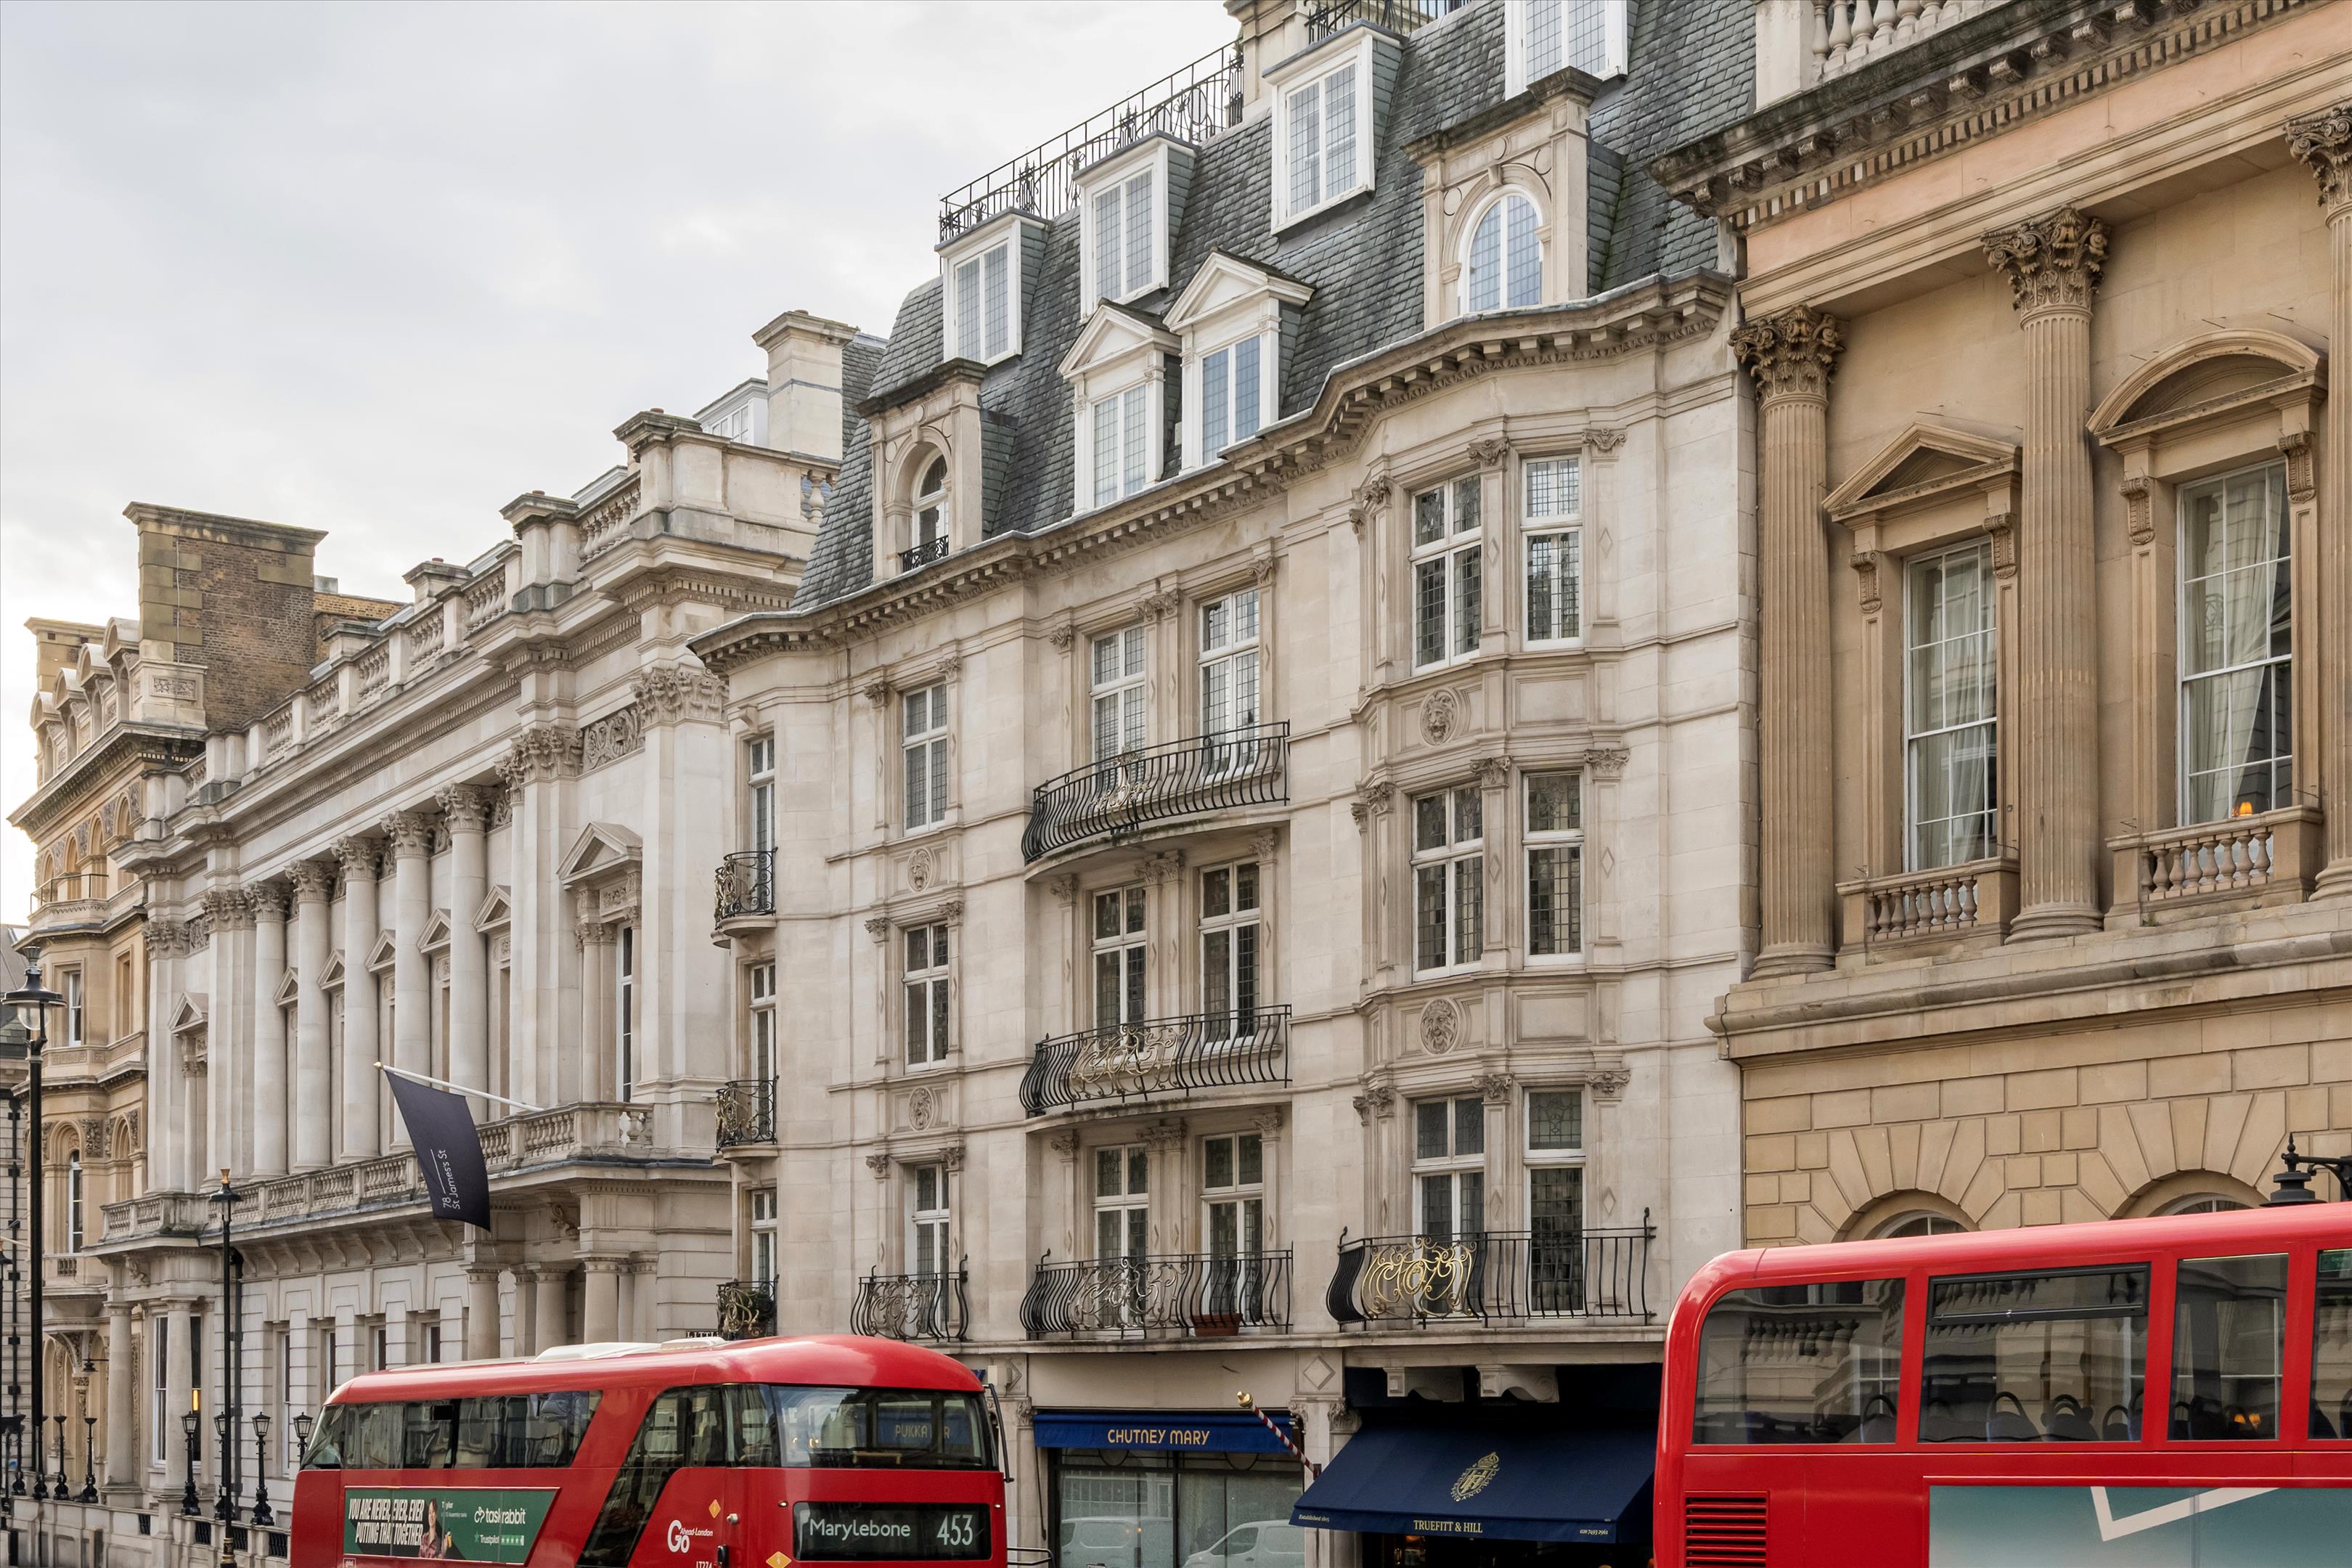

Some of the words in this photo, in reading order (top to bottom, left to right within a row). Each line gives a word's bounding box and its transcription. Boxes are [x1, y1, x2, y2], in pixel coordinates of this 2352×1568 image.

[438, 1149, 447, 1159] St
[443, 1161, 458, 1198] James's
[442, 1197, 452, 1208] 78
[452, 1199, 460, 1209] St
[894, 1424, 928, 1438] PUKKA
[1107, 1429, 1166, 1444] CHUTNEY
[1169, 1429, 1210, 1445] MARY
[348, 1498, 362, 1520] YOU
[359, 1498, 372, 1520] ARE
[408, 1499, 425, 1522] EVER
[355, 1522, 380, 1544] PUTTING
[378, 1522, 394, 1544] THAT
[393, 1523, 424, 1545] TOGETHER
[679, 1527, 713, 1537] Ahead-London
[809, 1519, 911, 1540] Marylebone
[936, 1514, 974, 1546] 453
[1413, 1519, 1454, 1532] TRUEFITT
[1454, 1522, 1462, 1532] &
[1463, 1522, 1483, 1533] HILL
[667, 1519, 690, 1553] Go
